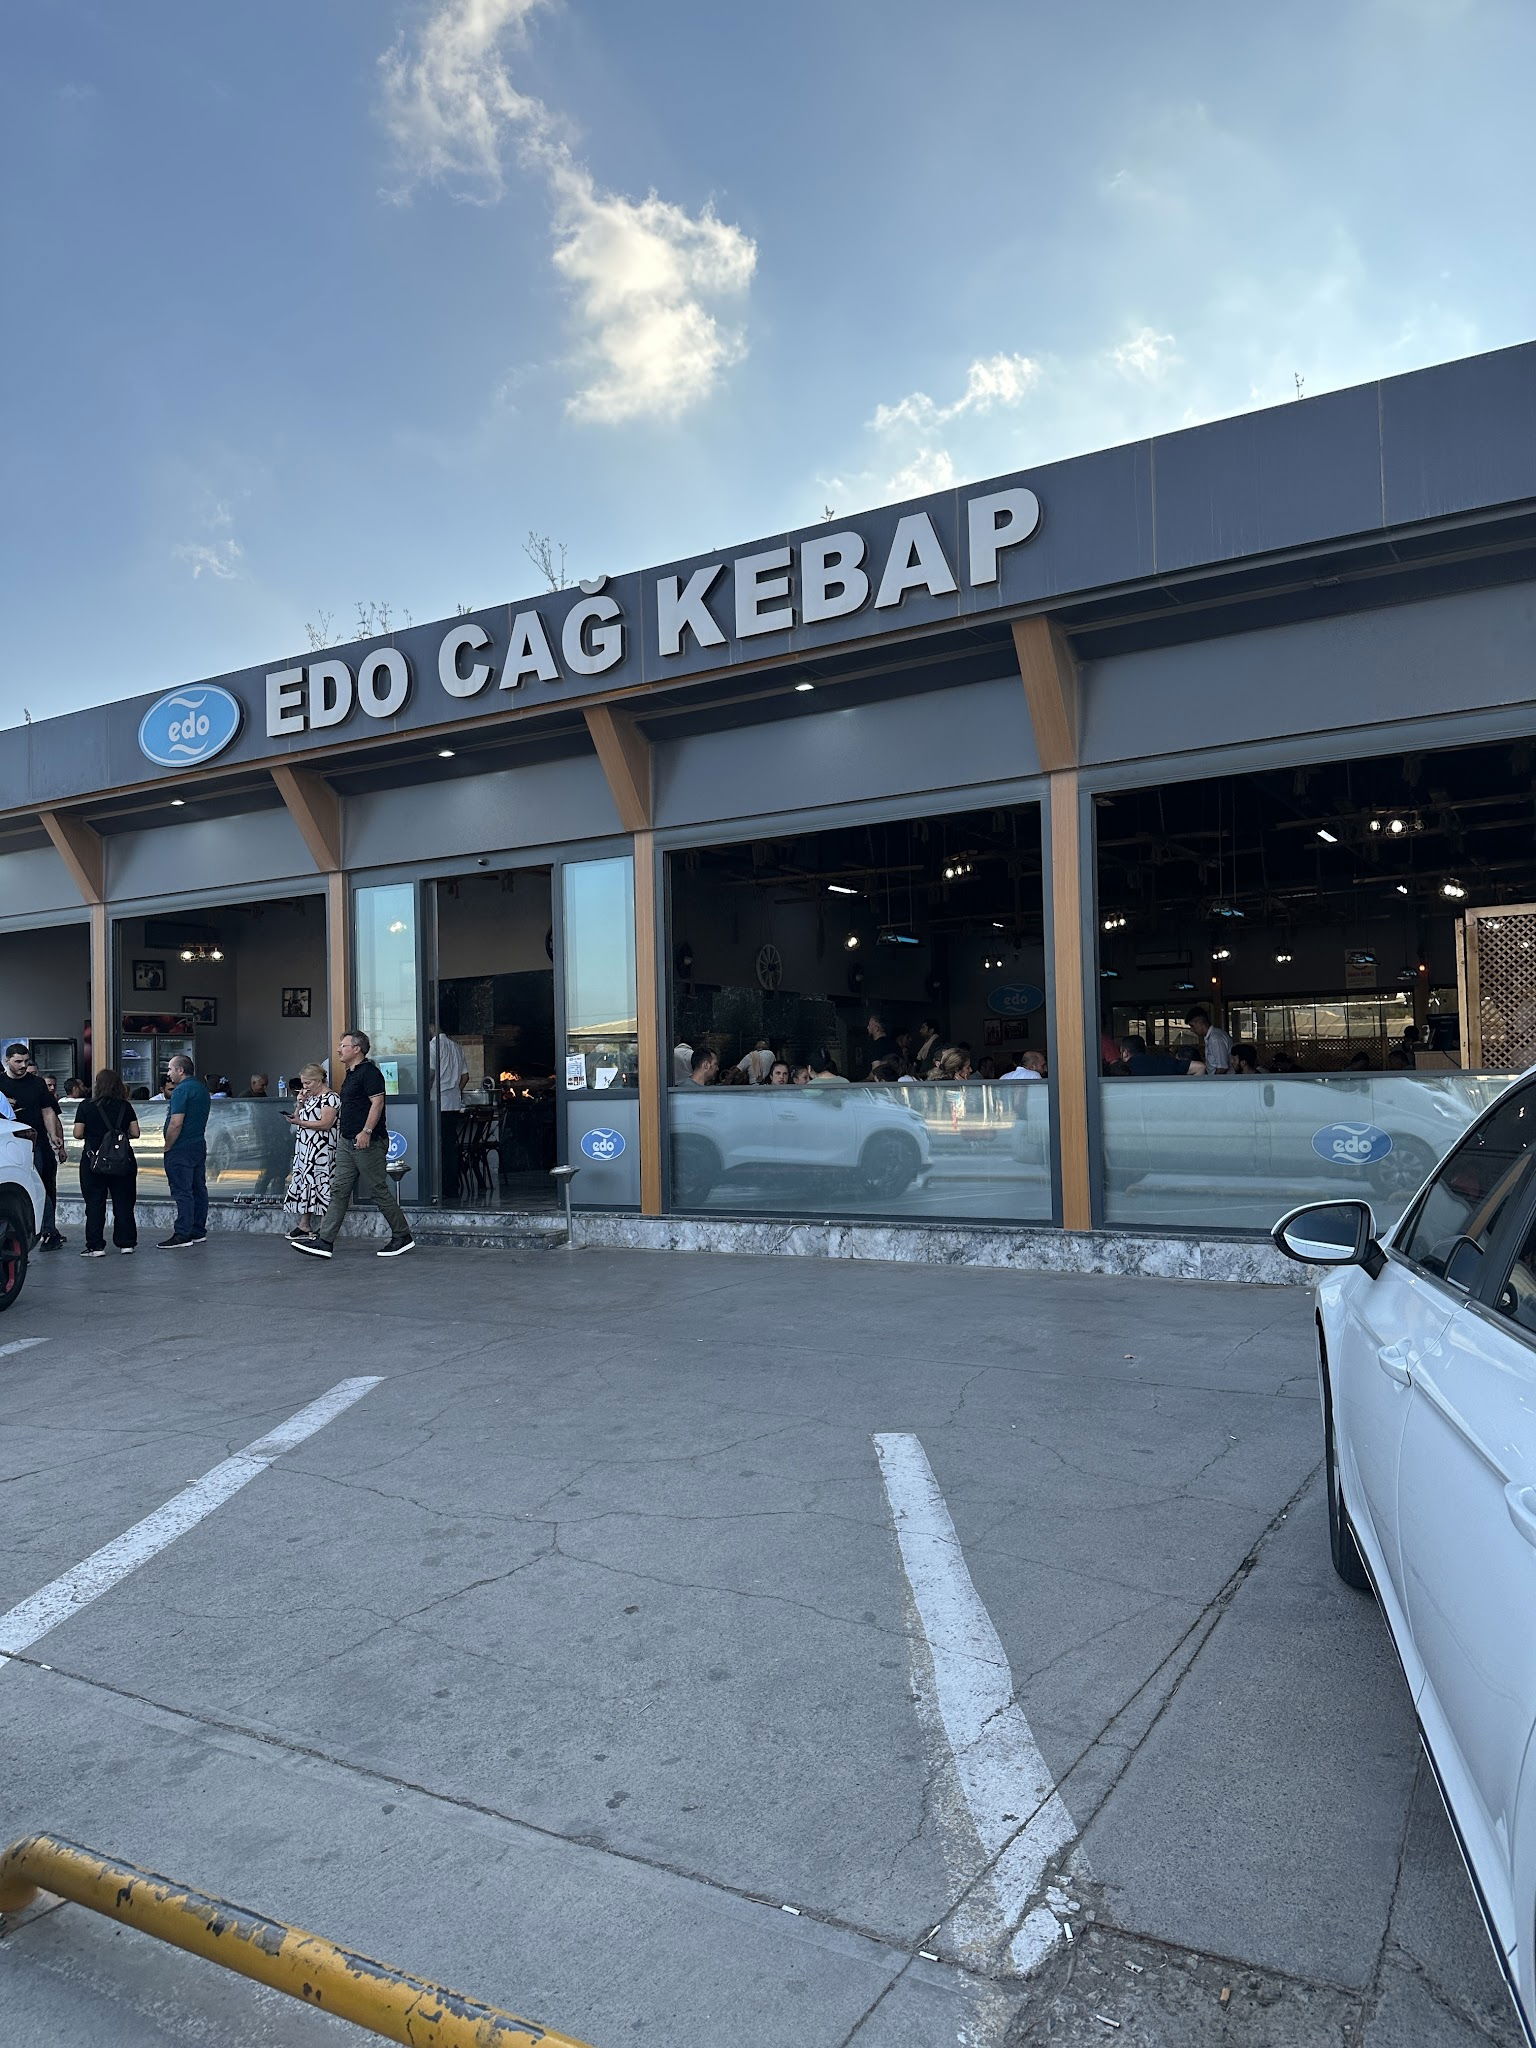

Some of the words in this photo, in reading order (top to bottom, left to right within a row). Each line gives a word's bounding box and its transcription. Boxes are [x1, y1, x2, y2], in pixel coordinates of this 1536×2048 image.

[266, 649, 410, 737] EDO
[438, 575, 625, 698] CAĞ
[656, 487, 1041, 656] KEBAP
[168, 711, 210, 742] edo
[1003, 993, 1028, 1006] edo
[592, 1139, 615, 1152] edo
[1332, 1135, 1372, 1153] edo
